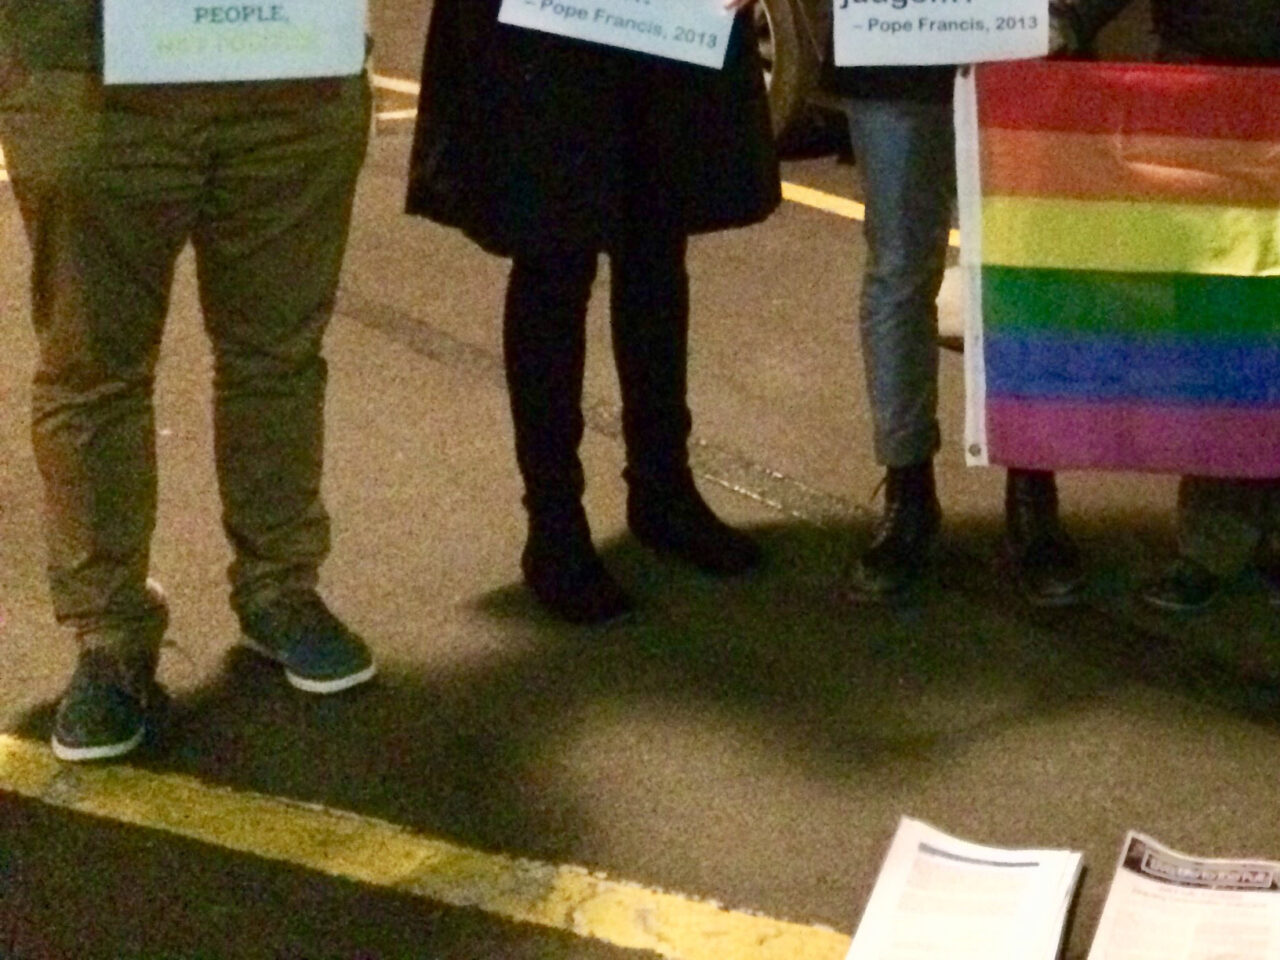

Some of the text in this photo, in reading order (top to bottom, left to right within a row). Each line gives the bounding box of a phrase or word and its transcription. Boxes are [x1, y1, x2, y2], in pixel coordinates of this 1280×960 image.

[594, 8, 668, 38] Francis,
[674, 26, 718, 48] 2013
[868, 18, 912, 35] Pope
[919, 18, 989, 33] Francis,
[996, 17, 1037, 30] 2013
